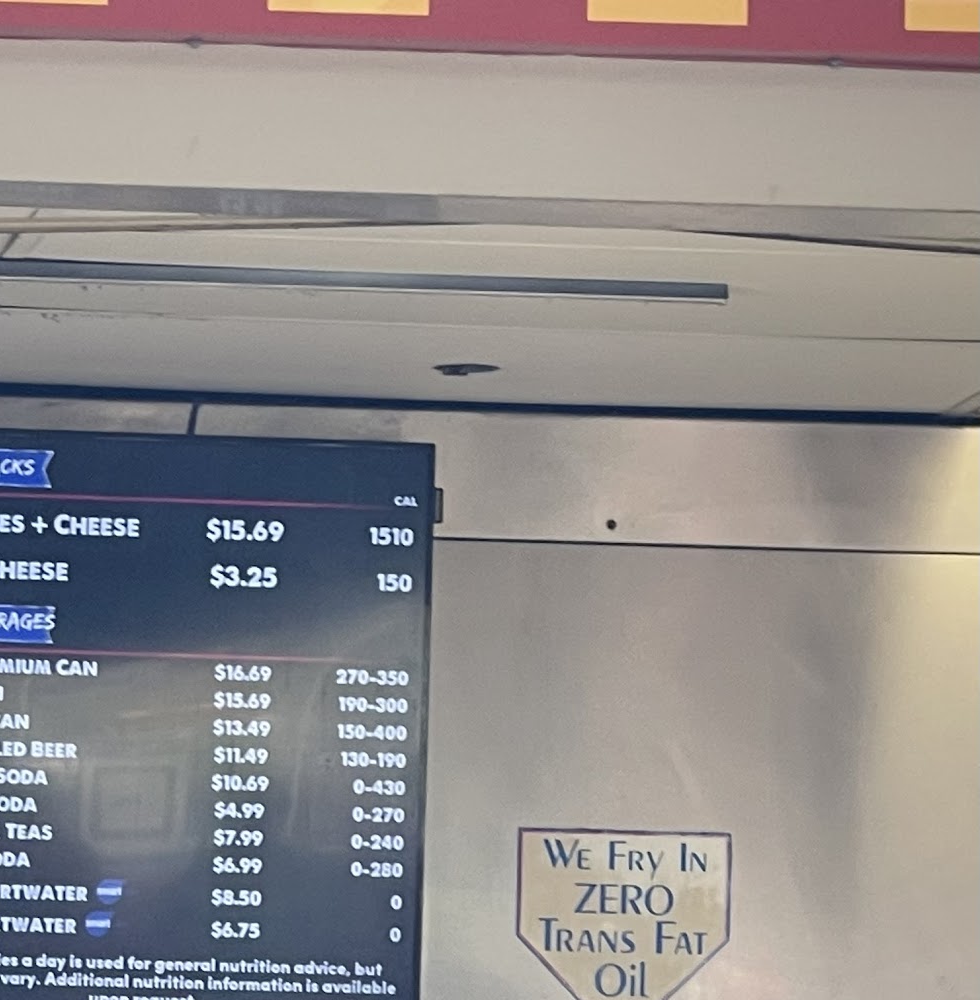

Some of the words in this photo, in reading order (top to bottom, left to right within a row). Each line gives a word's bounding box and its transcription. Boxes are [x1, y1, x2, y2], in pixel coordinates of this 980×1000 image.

[394, 494, 419, 508] CAL
[31, 516, 48, 535] +
[53, 513, 141, 539] CHEESE
[206, 516, 286, 544] $15.69
[369, 525, 415, 549] 1510
[209, 563, 278, 591] $3.25
[376, 572, 413, 594] 150
[56, 659, 99, 679] CAN
[214, 664, 272, 685] $16.69
[336, 668, 410, 688] 270-350
[213, 691, 271, 712] $15.69
[337, 696, 408, 716] 190-300
[212, 719, 271, 740] $13.49
[336, 723, 408, 743] 150-400
[30, 740, 78, 760] BEER
[213, 746, 269, 766] $11.49
[340, 751, 407, 770] 130-190
[211, 773, 270, 794] $10.69
[352, 778, 406, 798] 0-430
[213, 801, 265, 821] $4.99
[351, 805, 406, 825] 0-270
[3, 823, 54, 842] TEAS
[212, 829, 264, 849] $7.99
[350, 833, 405, 853] 0-240
[212, 856, 263, 876] $6.99
[350, 861, 404, 881] 0-280
[211, 889, 262, 909] $8.50
[390, 895, 404, 911] 0
[574, 882, 675, 917] ZERO
[210, 920, 261, 941] $6.75
[389, 927, 402, 944] 0
[21, 956, 33, 968] a
[35, 953, 67, 972] day
[69, 954, 83, 969] is
[86, 955, 125, 970] used
[127, 956, 152, 971] for
[154, 958, 216, 975] general
[219, 959, 291, 975] nutrition
[294, 960, 351, 978] advice,
[354, 962, 383, 977] but
[0, 973, 42, 990] vary.
[44, 972, 130, 989] Additional
[132, 975, 205, 991] nutrition
[207, 976, 303, 993] information
[305, 978, 319, 994] is
[321, 980, 397, 995] available
